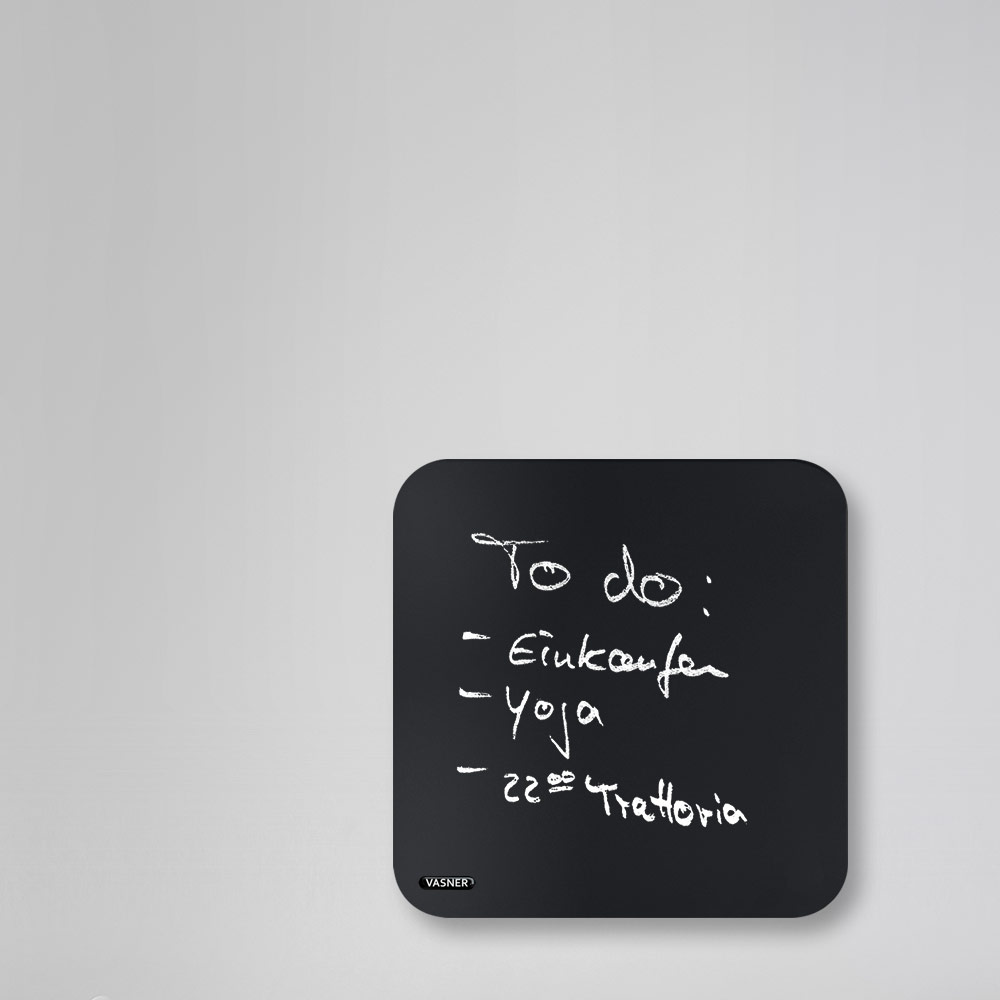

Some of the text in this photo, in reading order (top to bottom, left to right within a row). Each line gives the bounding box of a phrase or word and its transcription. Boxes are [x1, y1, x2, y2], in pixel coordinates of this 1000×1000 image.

[471, 533, 572, 591] To
[585, 775, 748, 828] Trattoria
[425, 878, 469, 888] VASNER
